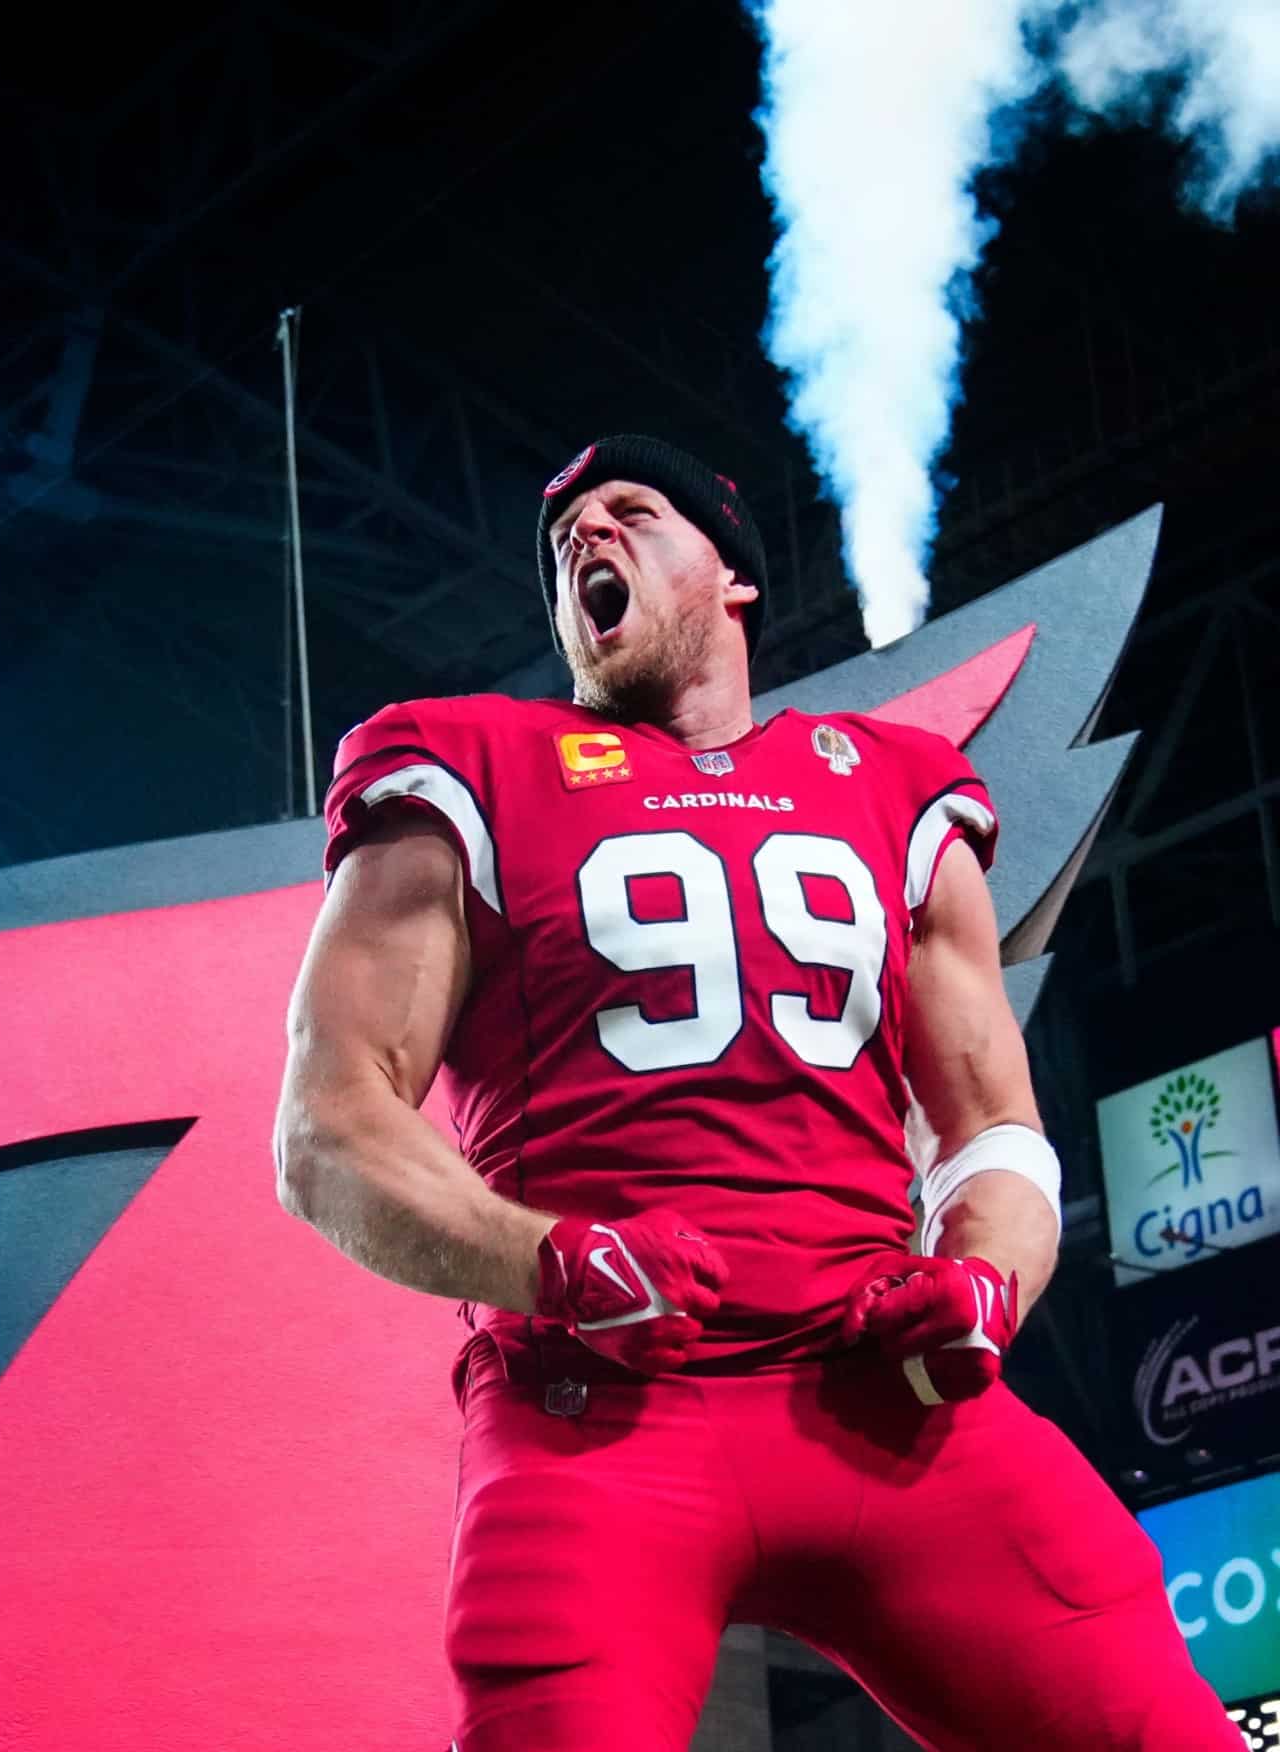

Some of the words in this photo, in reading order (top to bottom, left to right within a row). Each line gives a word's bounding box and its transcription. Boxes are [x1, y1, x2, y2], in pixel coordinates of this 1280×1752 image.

[560, 732, 625, 771] C
[643, 791, 795, 812] CARDINALS
[577, 830, 887, 1072] 99
[1134, 1184, 1264, 1259] Cigna
[1167, 1547, 1280, 1638] CO
